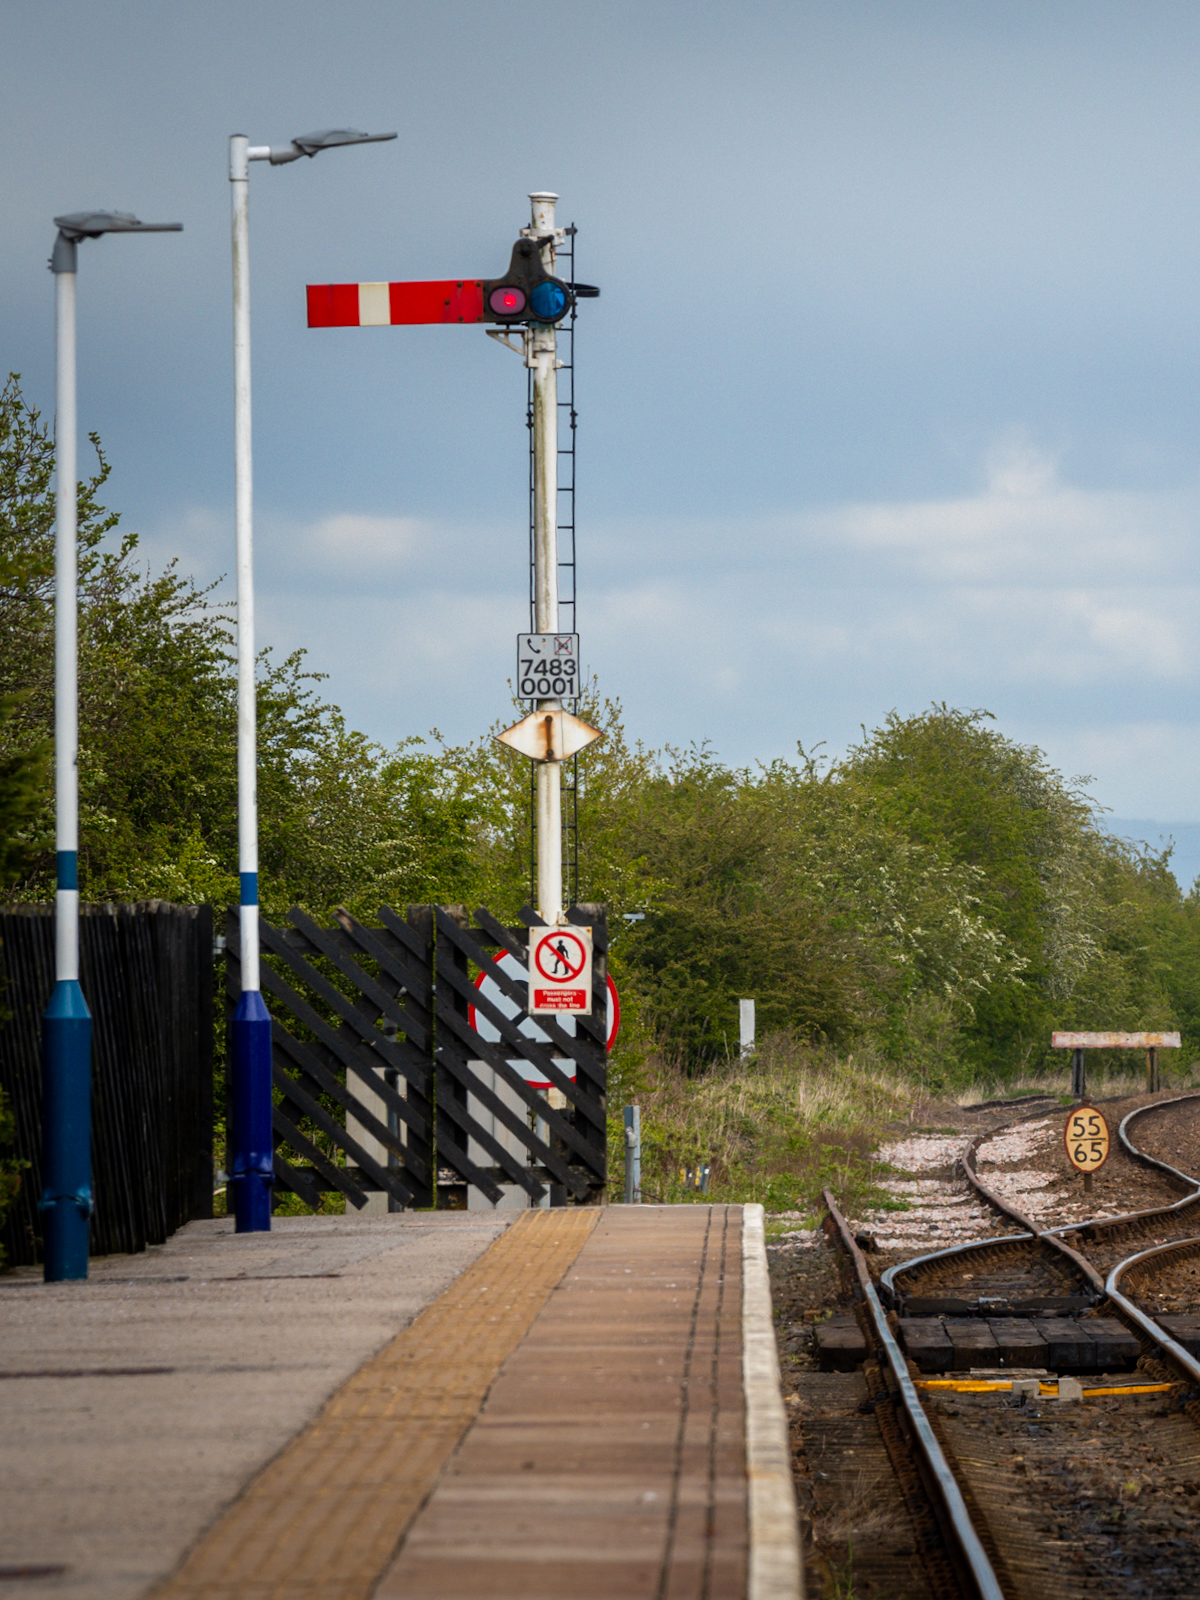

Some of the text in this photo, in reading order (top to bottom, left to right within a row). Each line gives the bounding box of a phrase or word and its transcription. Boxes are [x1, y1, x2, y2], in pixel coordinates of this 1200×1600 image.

[521, 659, 576, 676] 7483
[521, 677, 574, 695] 0001
[1073, 1116, 1101, 1138] 55
[1074, 1142, 1103, 1163] 65
